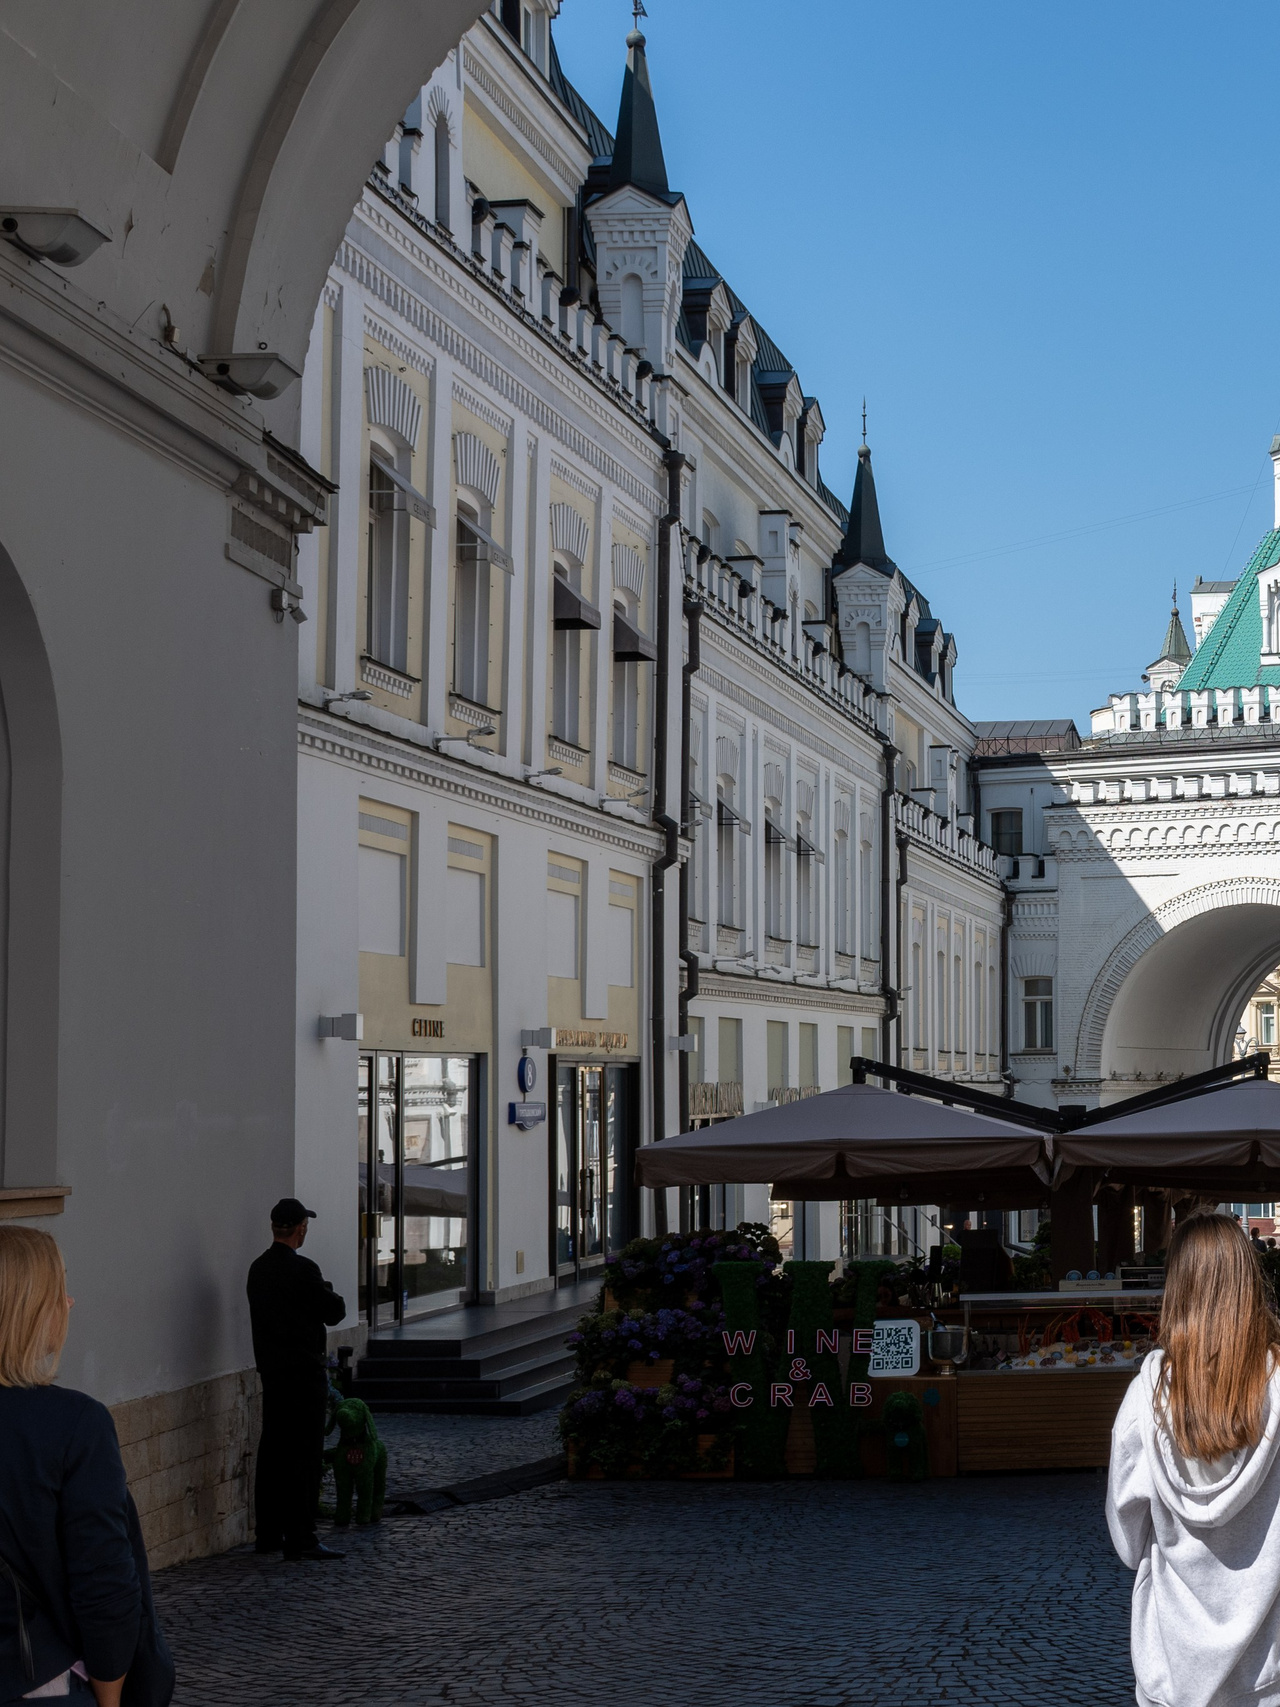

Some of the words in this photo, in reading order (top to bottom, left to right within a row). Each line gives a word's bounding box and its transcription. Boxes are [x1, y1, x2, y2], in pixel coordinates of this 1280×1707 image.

[527, 1063, 533, 1087] 8
[721, 1329, 875, 1356] WINE
[788, 1357, 812, 1381] &
[729, 1382, 873, 1408] CRAB
